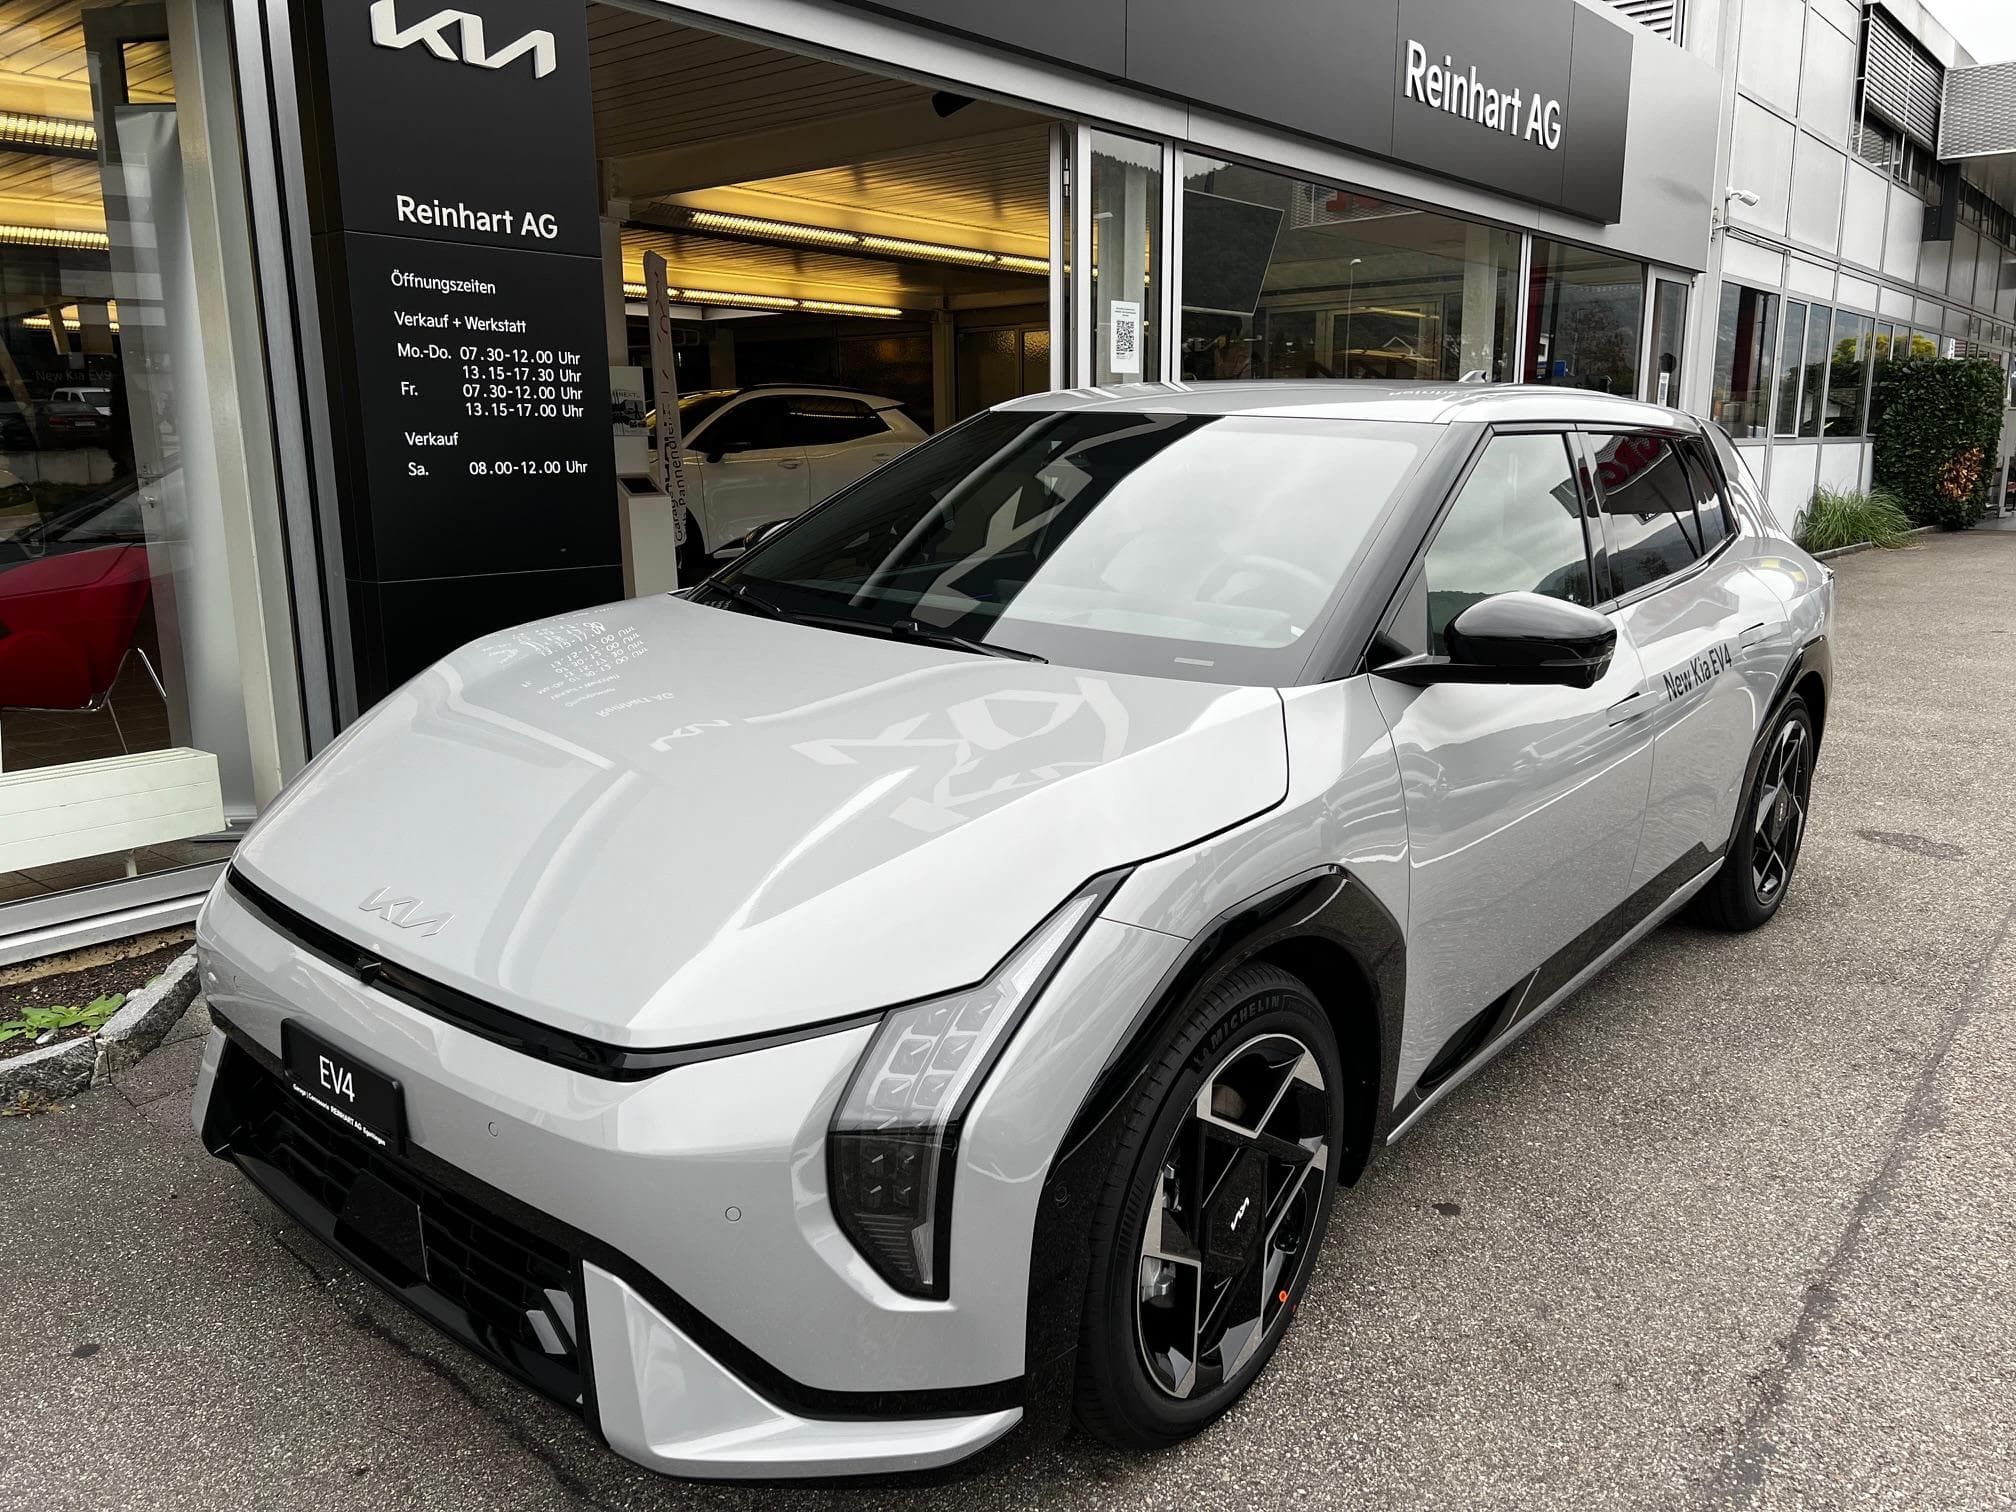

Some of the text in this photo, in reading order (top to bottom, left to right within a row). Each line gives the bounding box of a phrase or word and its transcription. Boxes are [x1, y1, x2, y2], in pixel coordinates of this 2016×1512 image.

[1404, 39, 1561, 150] Reinhart AG
[396, 195, 558, 239] Reinhart AG
[391, 269, 496, 294] Öffnungszeiten
[394, 311, 527, 333] Verkauf + Werkstatt
[397, 343, 452, 360] Mo.-Do.
[558, 351, 580, 365] Uhr
[559, 369, 581, 383] Uhr
[401, 381, 418, 396] Fr.
[560, 386, 583, 401] Uhr
[562, 404, 584, 418] Uhr
[405, 432, 459, 446] Verkauf
[408, 462, 429, 477] Sa.
[566, 460, 588, 474] Uhr
[1663, 643, 1732, 702] New Kia EV4
[1211, 994, 1280, 1048] MICHELIN
[319, 1054, 356, 1102] EV4
